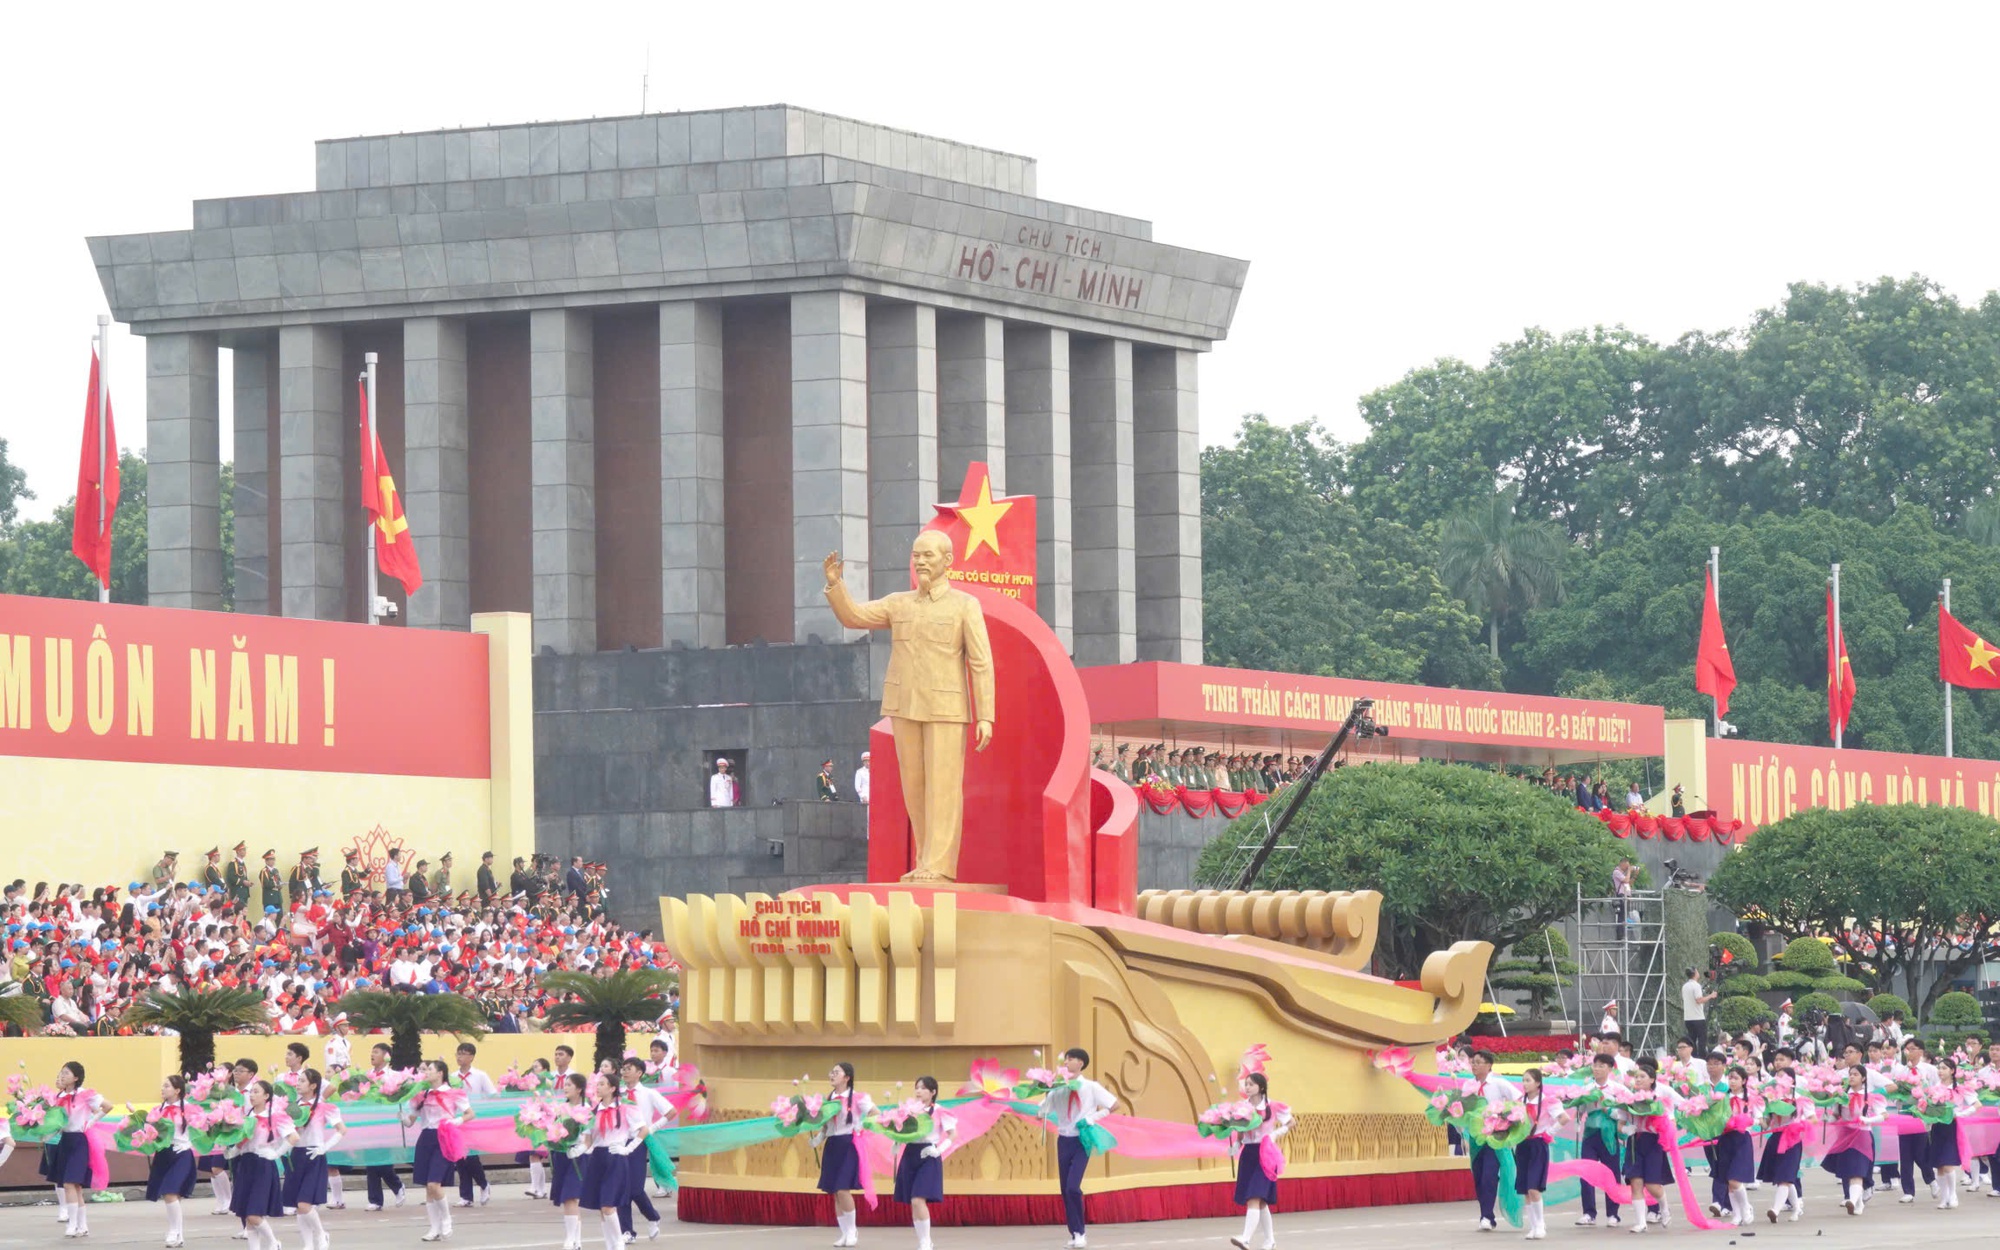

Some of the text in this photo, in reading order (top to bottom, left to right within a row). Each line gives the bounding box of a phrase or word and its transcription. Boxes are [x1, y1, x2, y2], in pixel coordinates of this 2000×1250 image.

[0, 624, 154, 736] MUÔN
[190, 634, 299, 744] NĂM
[1202, 684, 1238, 713] TINH
[1241, 680, 1281, 716] THẦN
[1284, 686, 1321, 720] CÁCH
[1324, 694, 1361, 727] MẠN
[1413, 698, 1443, 730] TÁM
[1445, 700, 1463, 732] VÀ
[1465, 701, 1498, 734] QUỐC
[1501, 706, 1544, 737] KHÁNH
[1546, 713, 1569, 739] 2-9
[1572, 708, 1596, 741] BẤT
[1732, 755, 1797, 827] NƯỚC
[765, 916, 791, 937] CHÍ
[797, 920, 840, 937] MINH
[788, 901, 821, 916] TỊCH
